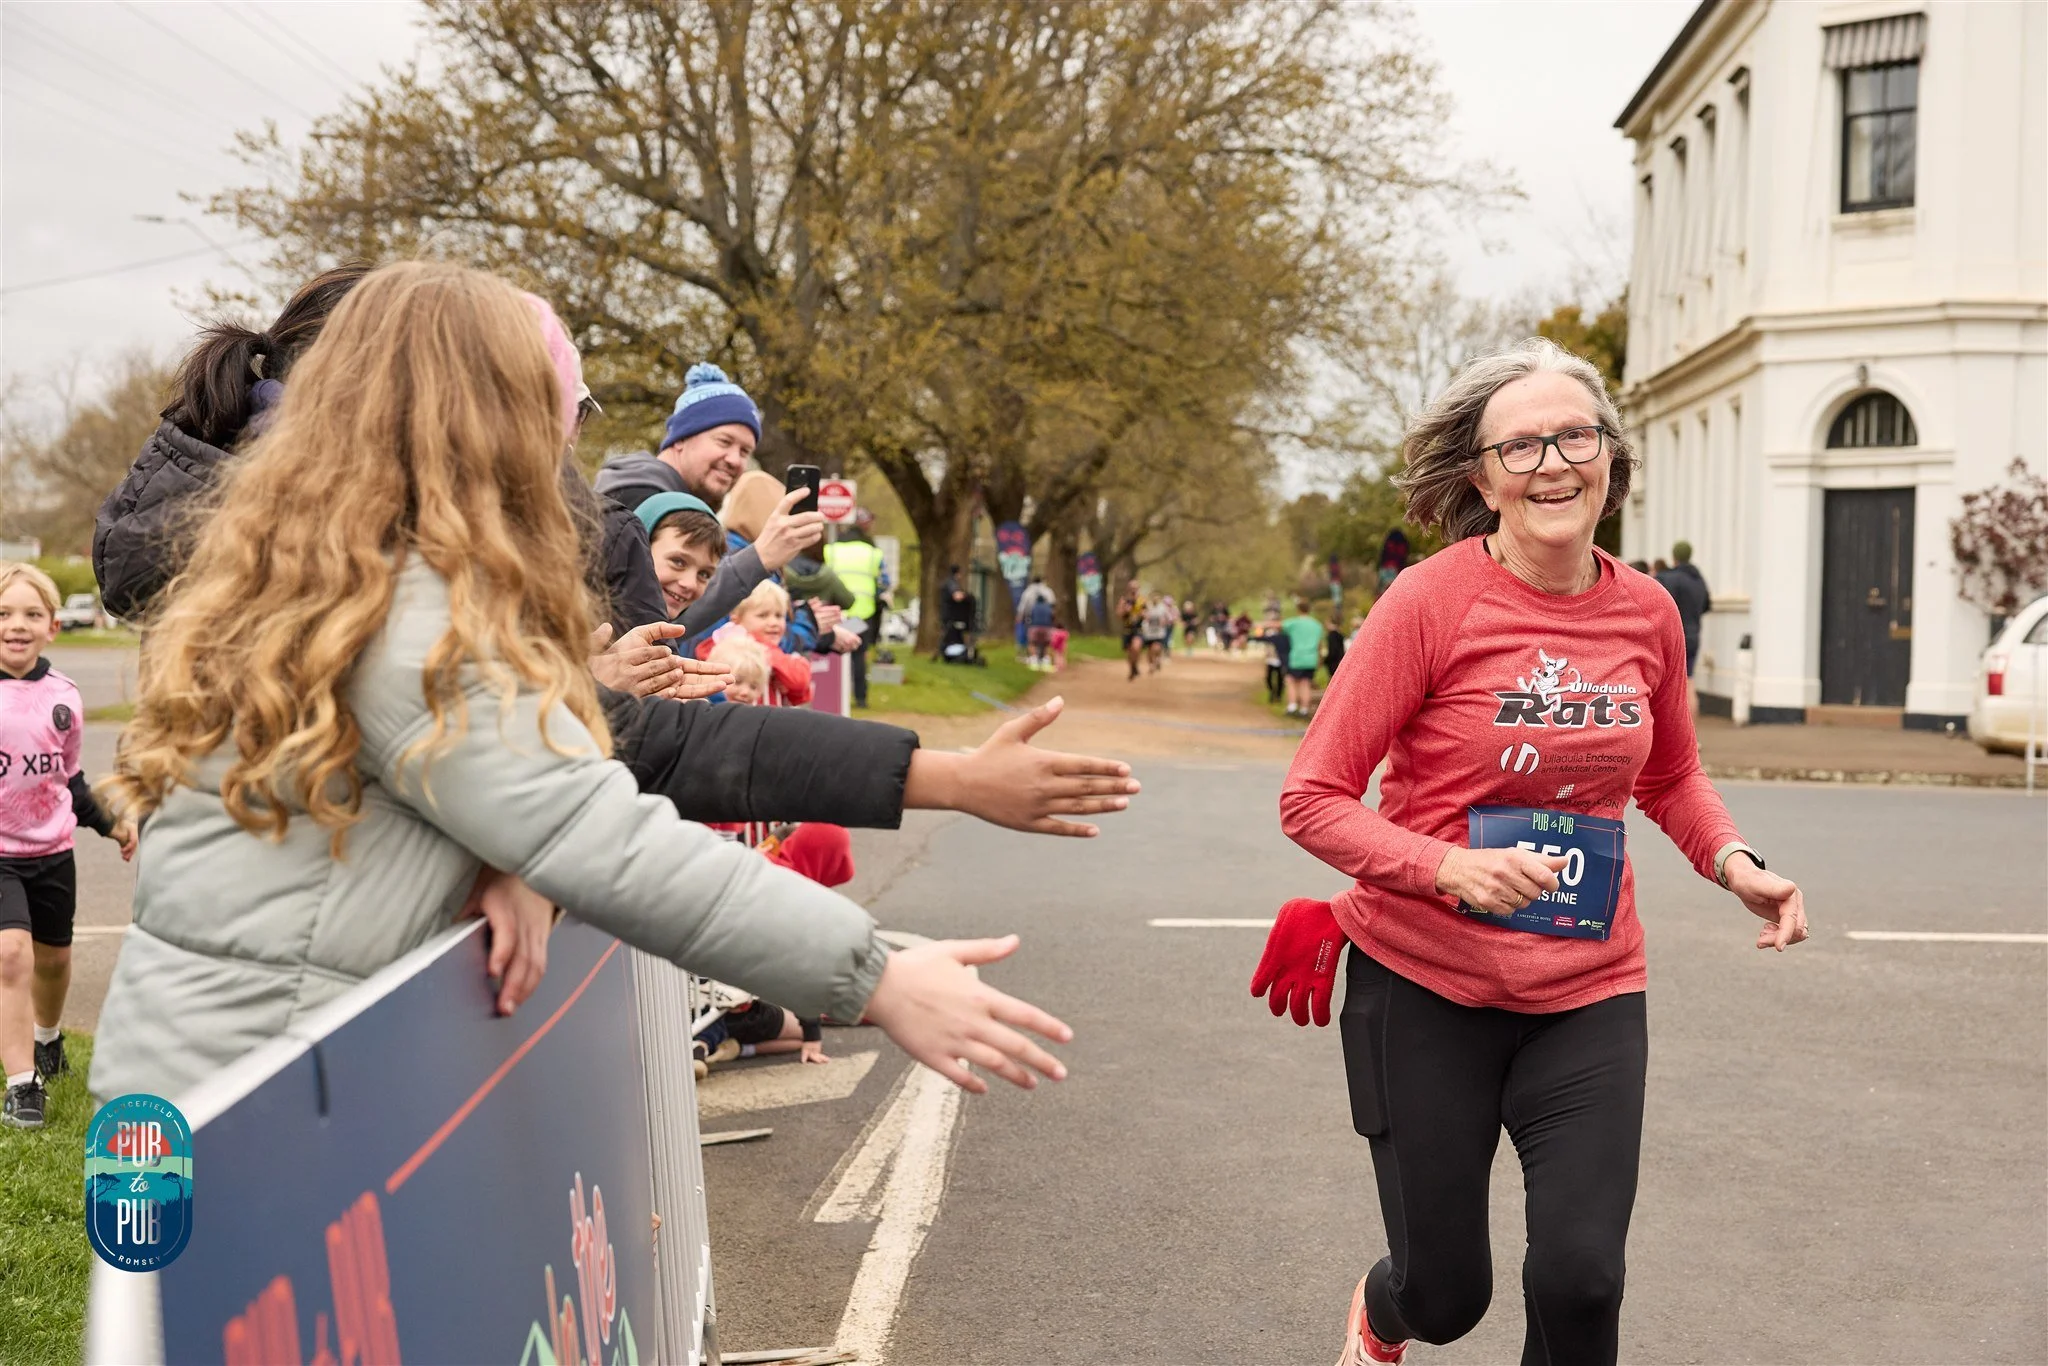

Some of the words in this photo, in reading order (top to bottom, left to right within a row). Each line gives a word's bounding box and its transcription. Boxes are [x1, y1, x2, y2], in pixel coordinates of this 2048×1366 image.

[1570, 681, 1637, 694] Ulladulla
[1493, 691, 1642, 728] Rats
[1544, 752, 1584, 764] Ulladulla
[1586, 753, 1633, 765] Endoscopy
[1541, 765, 1558, 774] and
[1559, 764, 1592, 773] Medical
[1593, 764, 1618, 774] Centre
[1532, 812, 1549, 831] PUB
[1558, 815, 1574, 835] PUB
